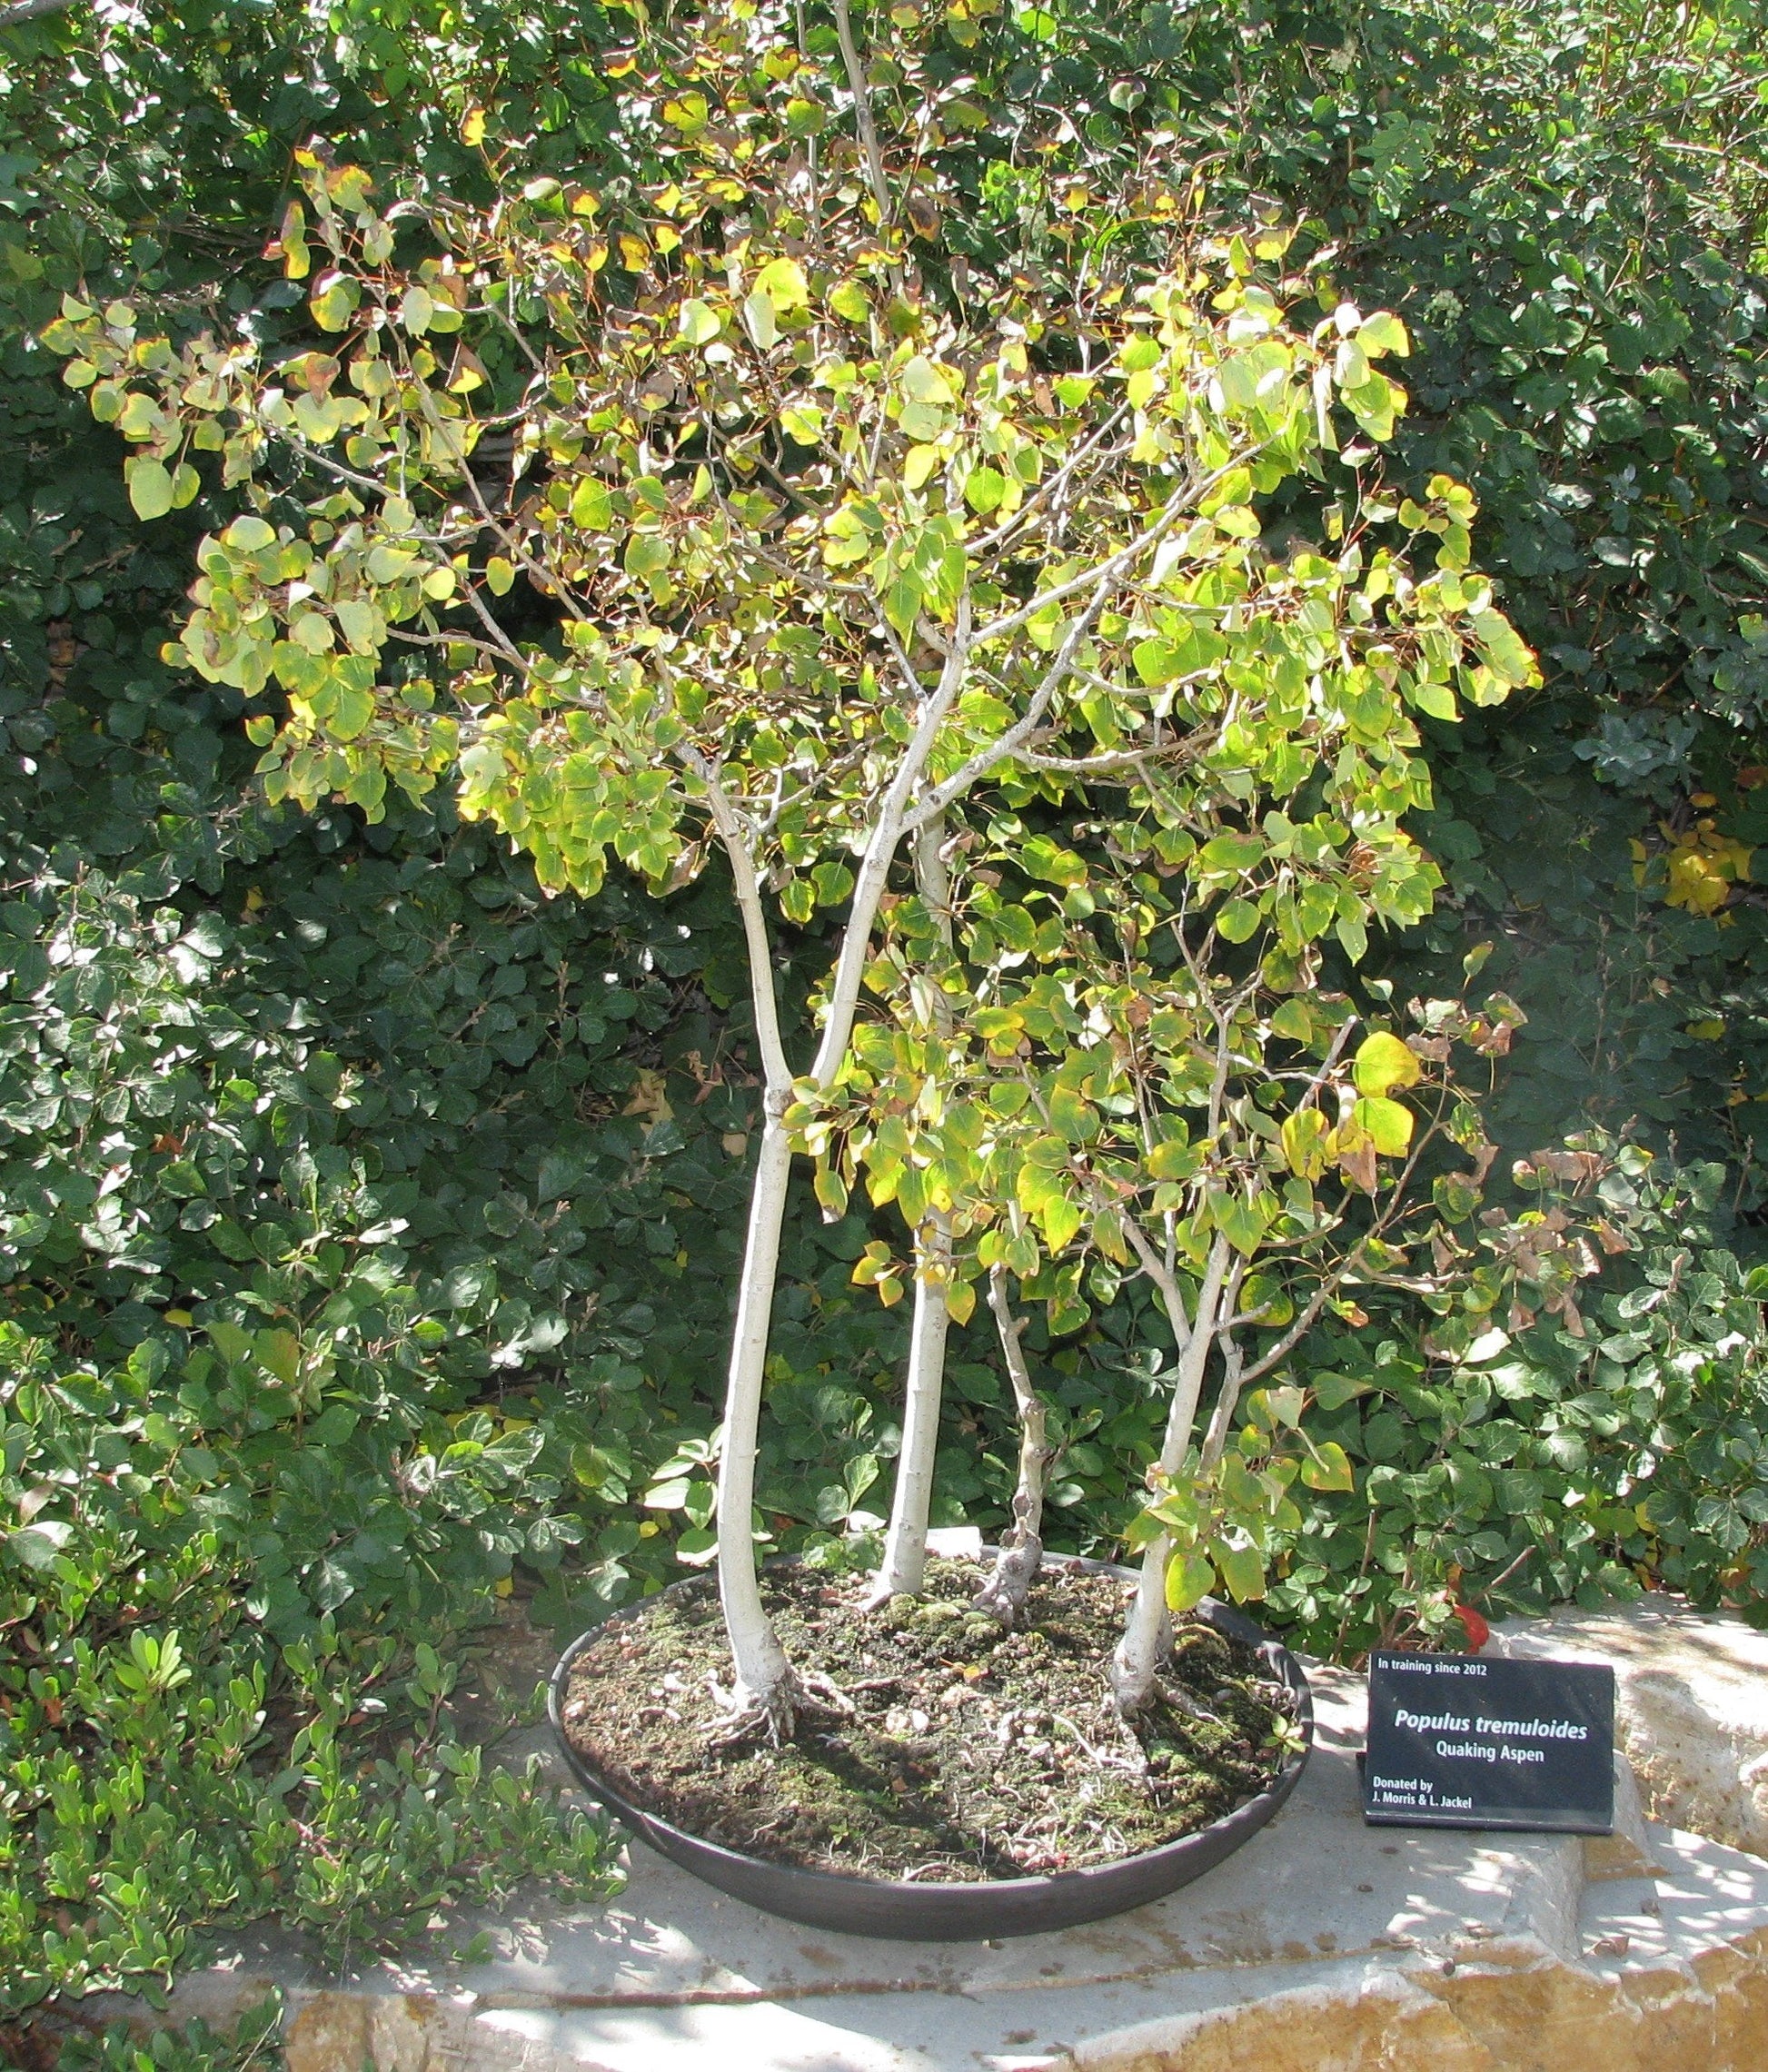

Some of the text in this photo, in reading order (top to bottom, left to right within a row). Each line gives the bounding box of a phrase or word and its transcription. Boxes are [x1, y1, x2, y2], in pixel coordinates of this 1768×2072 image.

[1378, 1658, 1486, 1676] In training since 2012
[1395, 1710, 1587, 1739] Populus tremuloides
[1436, 1740, 1544, 1764] Quaking Aspen
[1373, 1776, 1433, 1793] Donated by
[1372, 1792, 1472, 1809] J. Morris & L. Jackel
